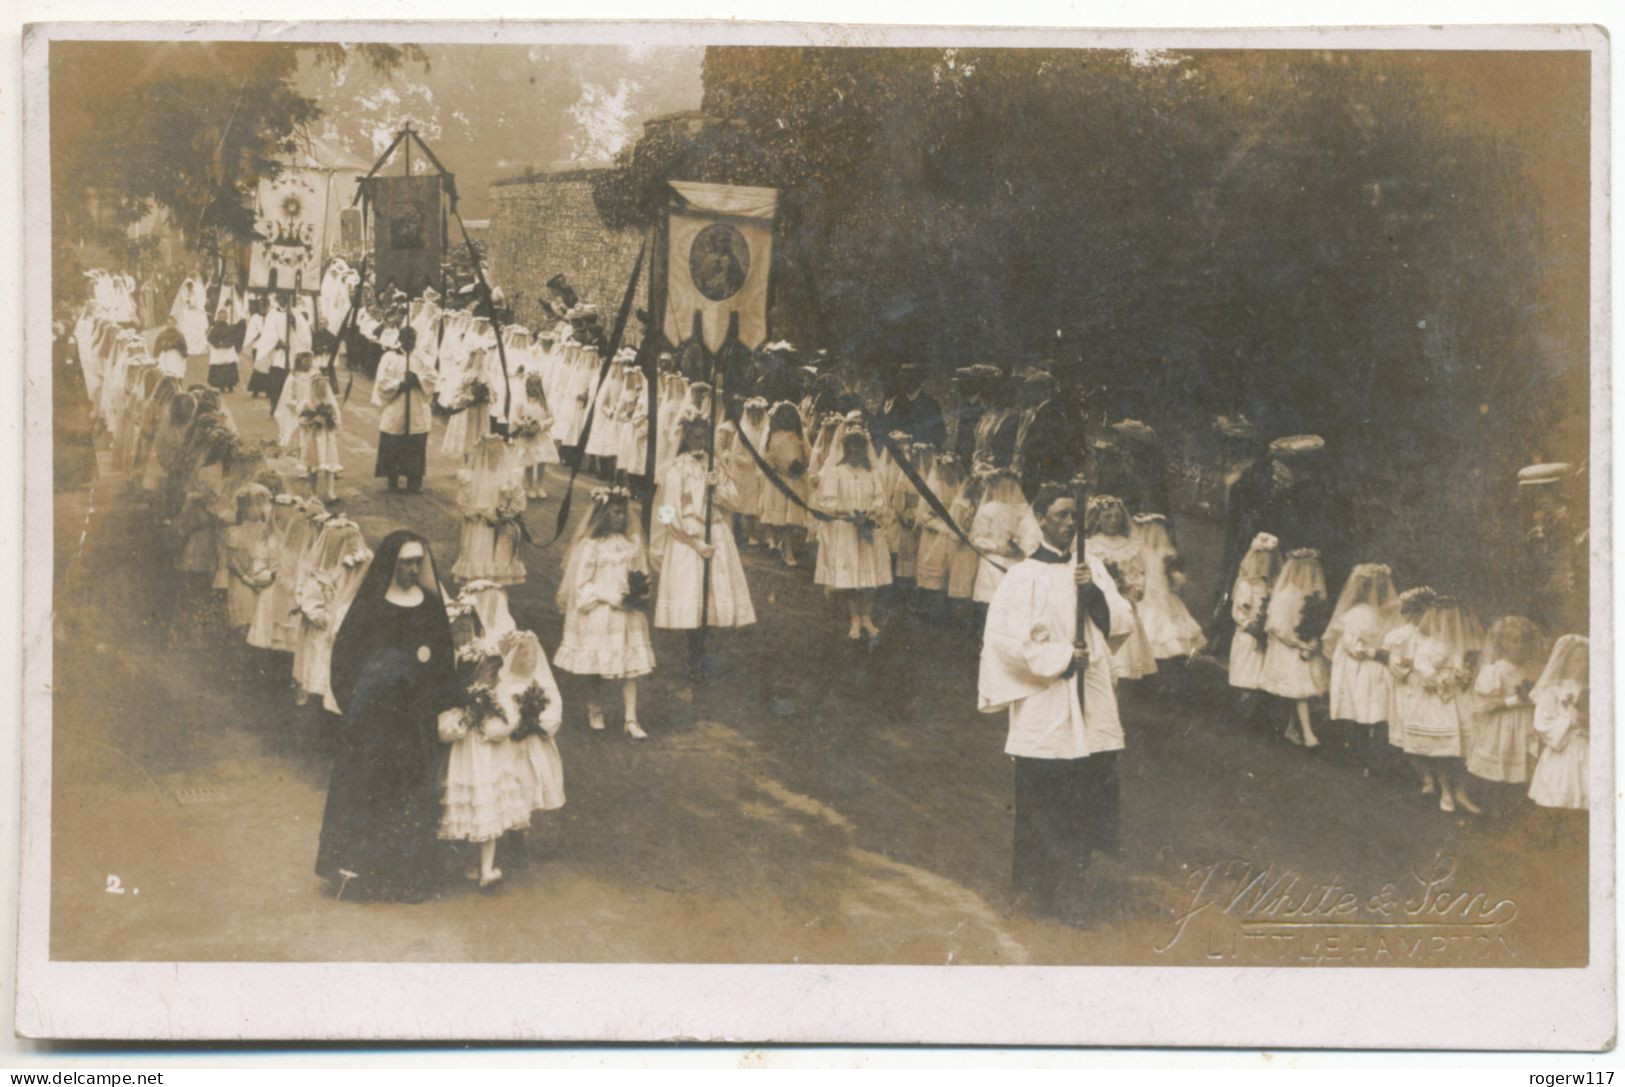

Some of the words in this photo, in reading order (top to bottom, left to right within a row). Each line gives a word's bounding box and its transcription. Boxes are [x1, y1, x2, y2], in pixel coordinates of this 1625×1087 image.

[1222, 860, 1358, 917] White
[1366, 883, 1398, 917] &
[1404, 852, 1517, 926] Son
[1206, 930, 1516, 962] LITTLEHAMPTON
